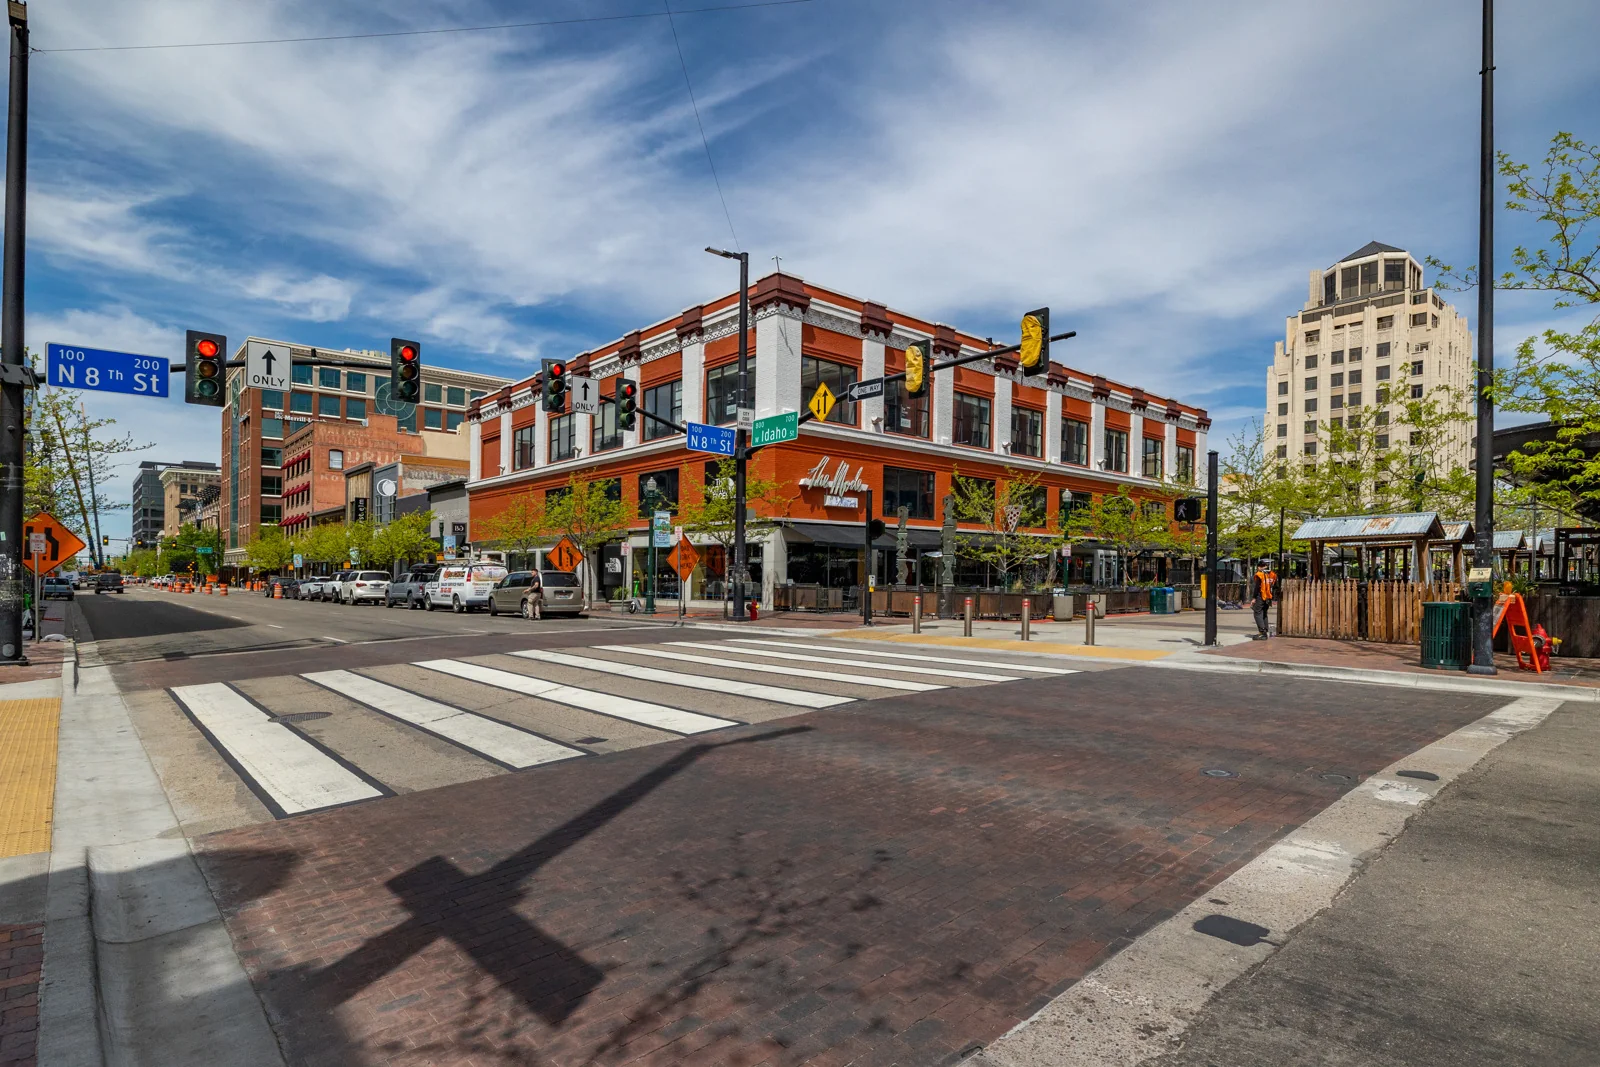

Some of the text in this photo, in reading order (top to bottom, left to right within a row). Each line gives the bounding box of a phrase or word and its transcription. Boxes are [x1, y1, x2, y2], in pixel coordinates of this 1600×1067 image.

[59, 349, 160, 371] 100 200
[58, 364, 160, 394] N 8 Th St
[252, 375, 285, 387] ONLY
[858, 387, 867, 395] ONE
[575, 402, 594, 411] ONLY
[691, 425, 732, 438] 100 200
[761, 427, 787, 442] Idaho
[691, 434, 731, 452] N 8 Th St
[808, 455, 830, 490] The
